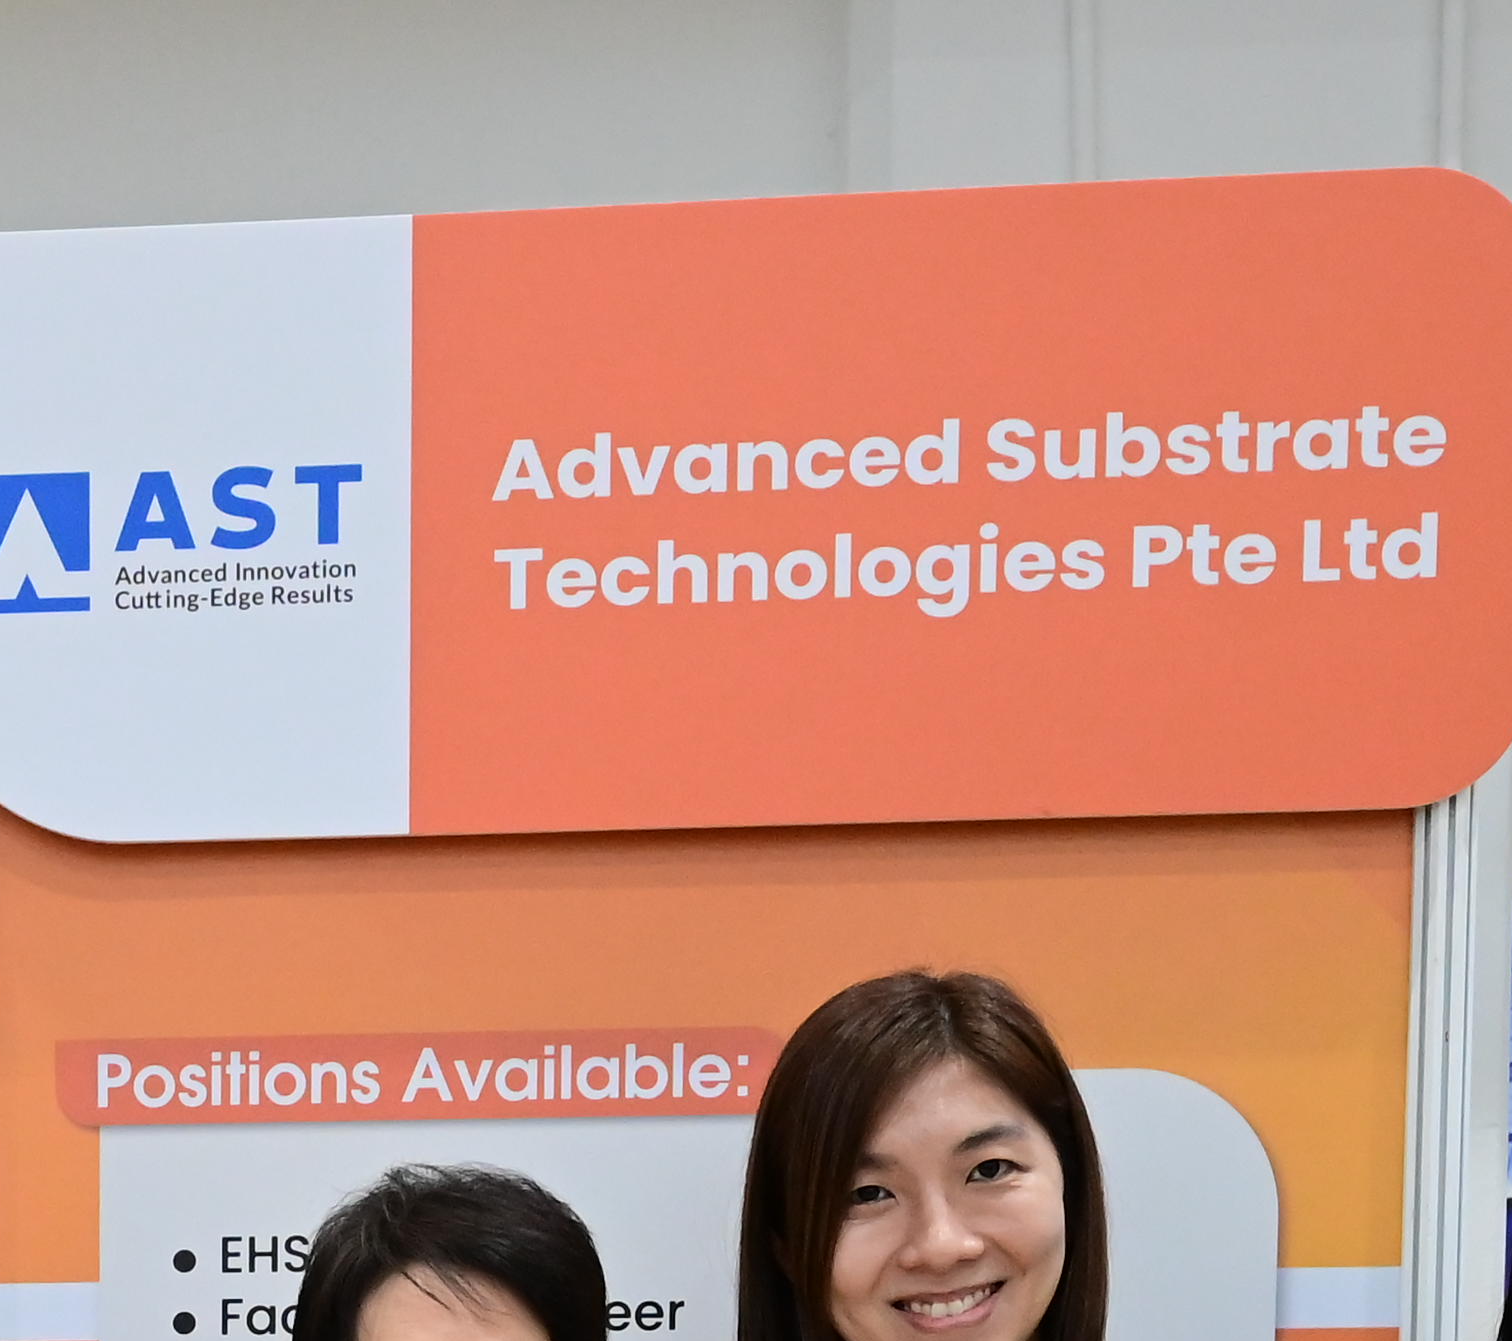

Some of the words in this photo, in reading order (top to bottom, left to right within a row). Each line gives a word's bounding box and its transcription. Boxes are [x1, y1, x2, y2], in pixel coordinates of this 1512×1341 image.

[491, 418, 961, 504] Advanced
[984, 402, 1448, 486] Substrate
[114, 462, 363, 552] AST
[114, 561, 233, 587] Advanced
[239, 555, 359, 584] Innovation
[114, 590, 262, 617] Cutting-Edge
[267, 583, 355, 609] Results
[495, 522, 1106, 620] Technologies
[1129, 520, 1272, 590] Pte
[1300, 513, 1442, 584] Ltd
[94, 1046, 380, 1112] Positions
[400, 1037, 753, 1108] Available:
[221, 1235, 311, 1274] EHS
